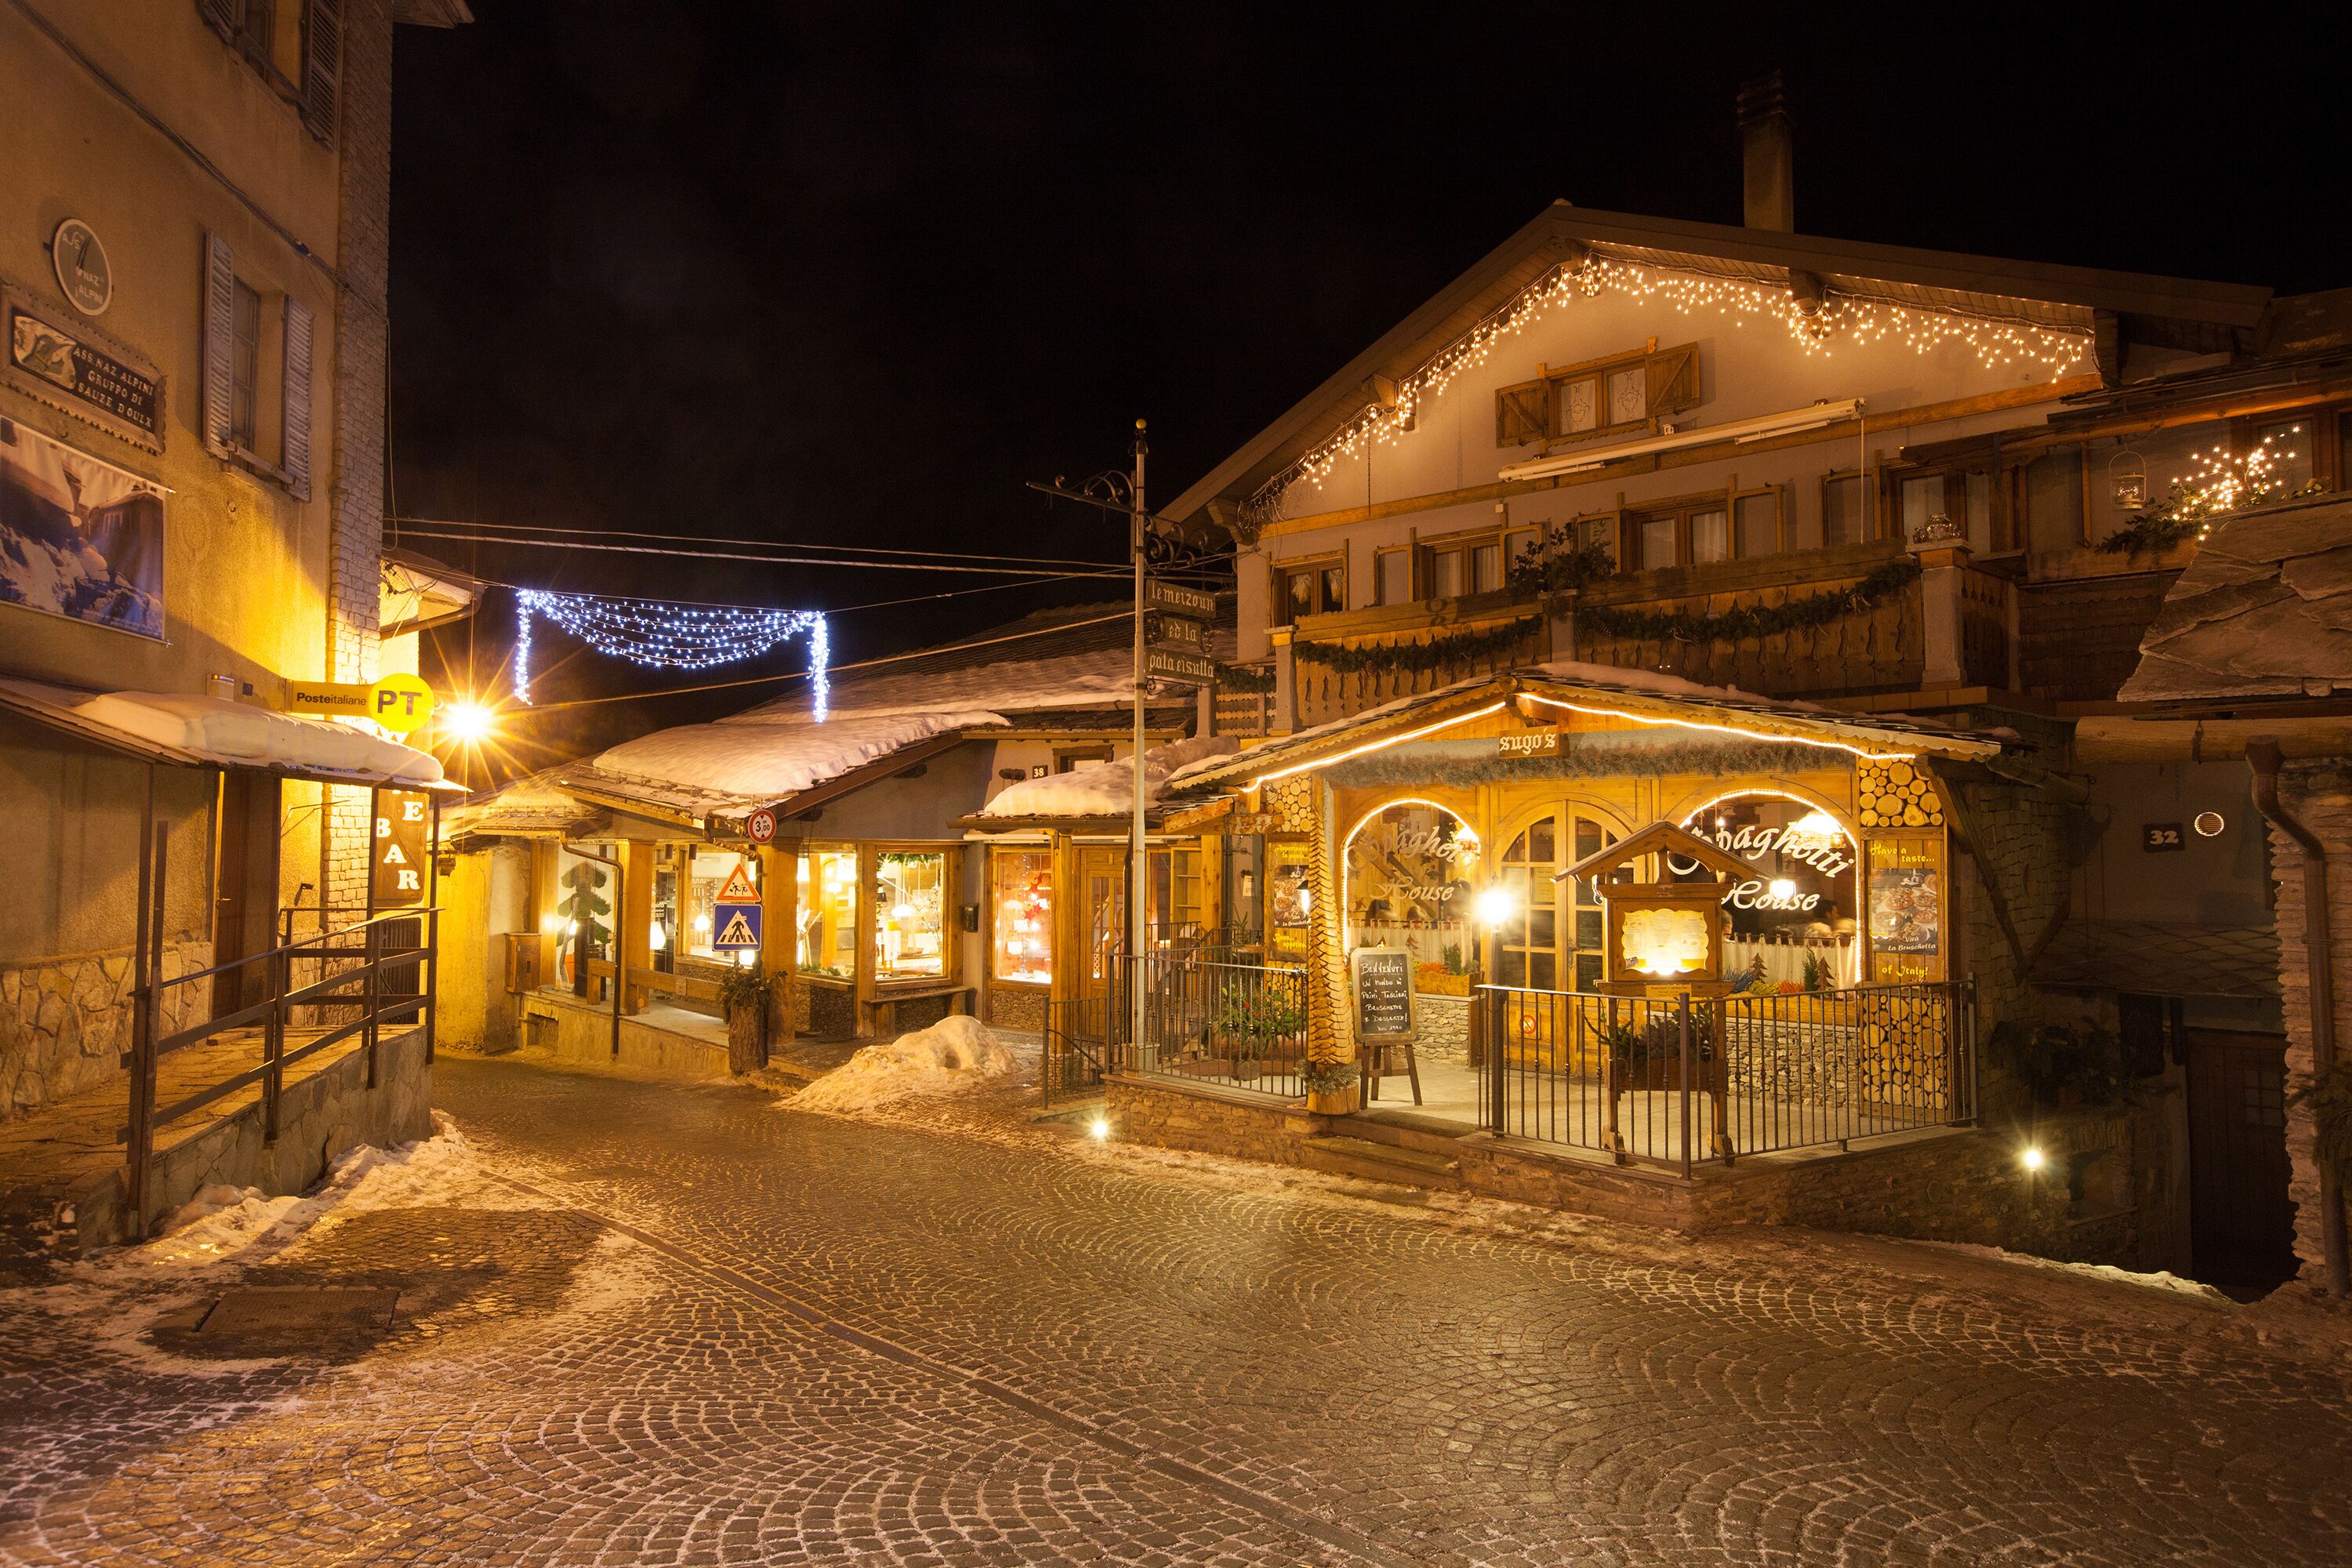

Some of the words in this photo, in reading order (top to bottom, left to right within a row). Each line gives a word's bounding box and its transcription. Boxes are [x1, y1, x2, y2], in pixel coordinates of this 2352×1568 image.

[78, 382, 113, 407] SAUZE
[88, 370, 127, 397] GRUPPO
[131, 393, 142, 405] DI
[120, 372, 154, 396] ALPINI
[377, 690, 423, 716] PT
[1499, 727, 1556, 756] sugo's
[1033, 768, 1044, 778] 38
[2149, 829, 2179, 844] 32
[1870, 843, 1898, 855] Have
[1370, 876, 1455, 902] House
[1882, 964, 1892, 975] of
[1896, 965, 1929, 979] Italy!
